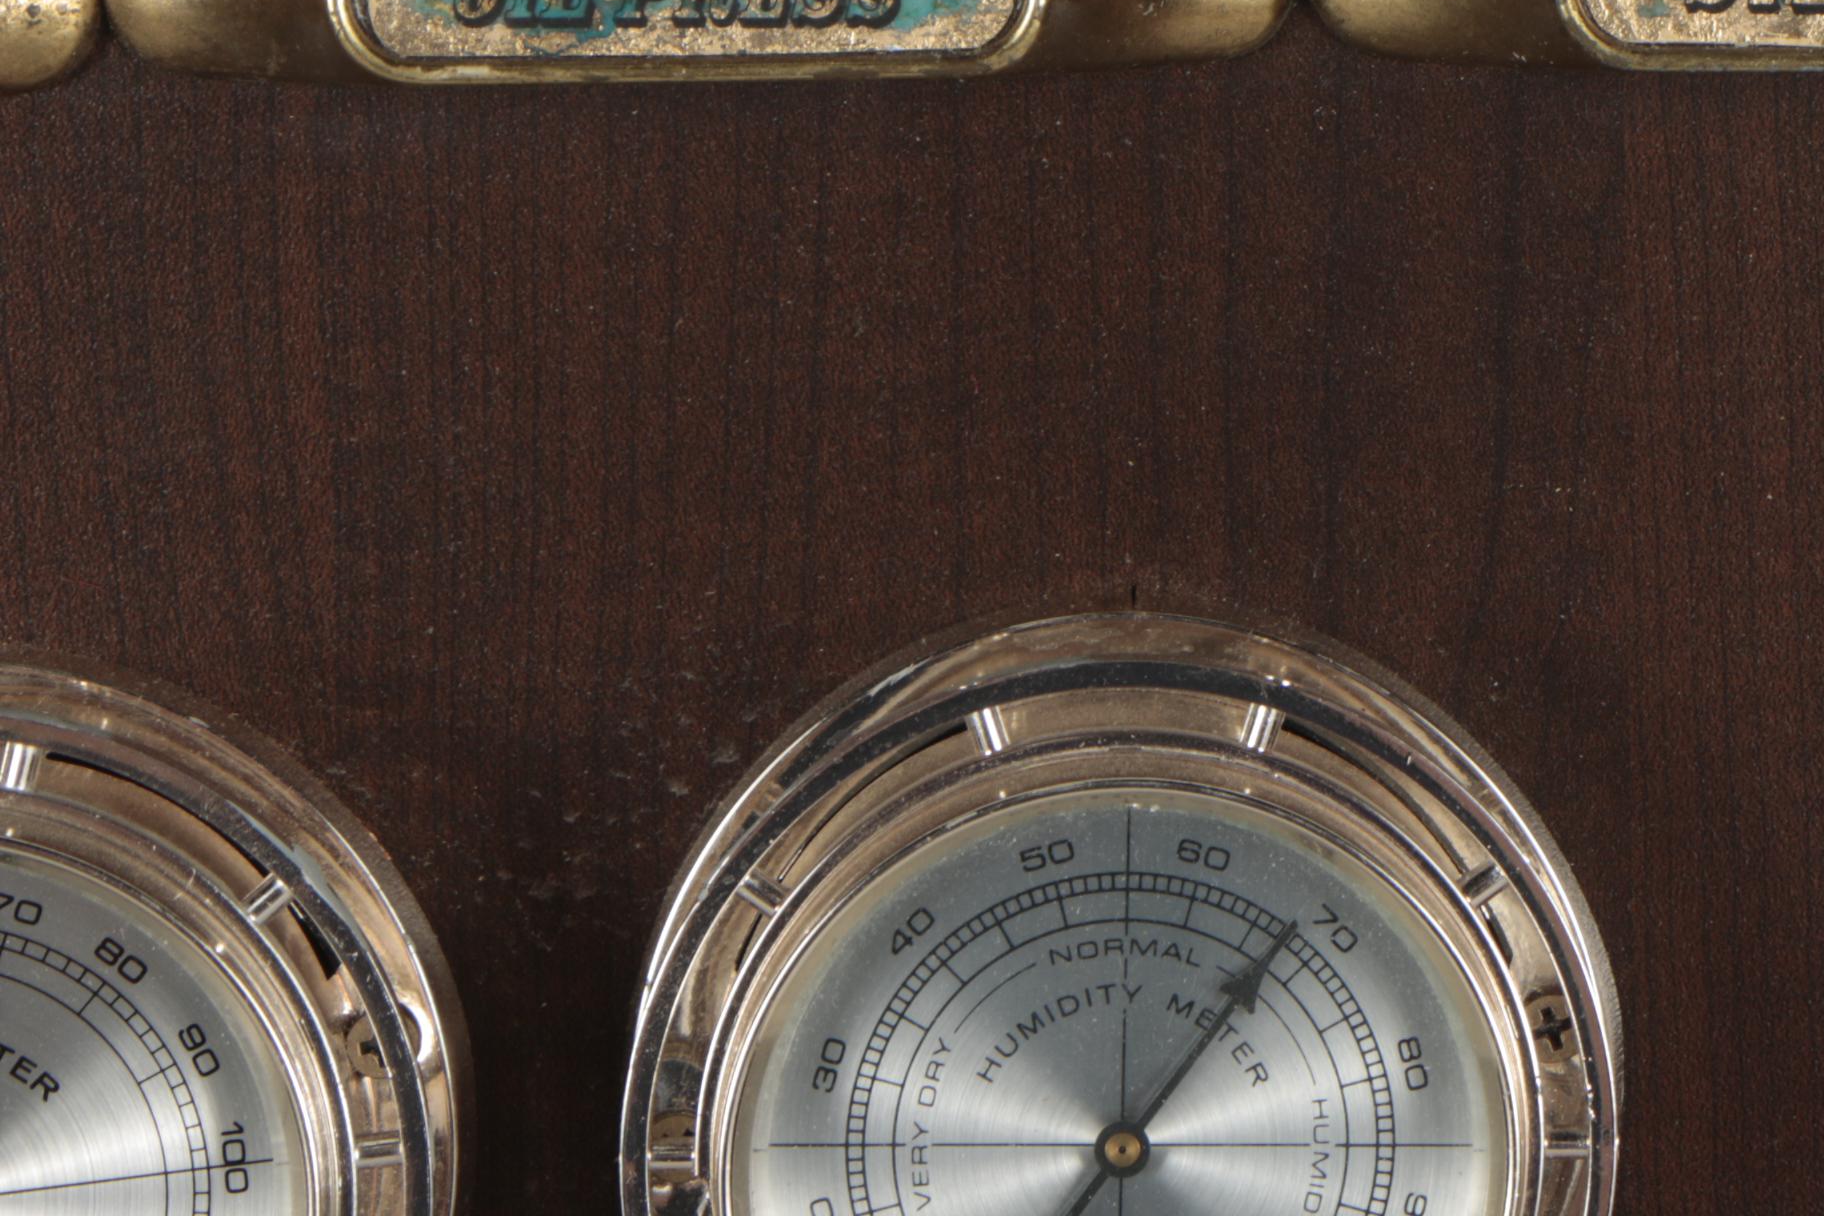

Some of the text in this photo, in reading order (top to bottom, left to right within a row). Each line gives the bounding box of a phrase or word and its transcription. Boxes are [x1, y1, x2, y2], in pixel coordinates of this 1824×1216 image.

[1019, 838, 1075, 872] 50
[1177, 838, 1231, 872] 60
[891, 907, 936, 956] 40
[1049, 937, 1200, 967] NORMAL
[1312, 903, 1359, 954] 70
[94, 936, 148, 985] 80
[178, 1022, 221, 1078] 90
[976, 983, 1270, 1088] HUMIDITY METER
[812, 1036, 847, 1093] 30
[1397, 1036, 1429, 1092] 80
[911, 1037, 953, 1211] VERY DRY
[221, 1121, 250, 1194] 100
[1303, 1098, 1331, 1214] HUMID
